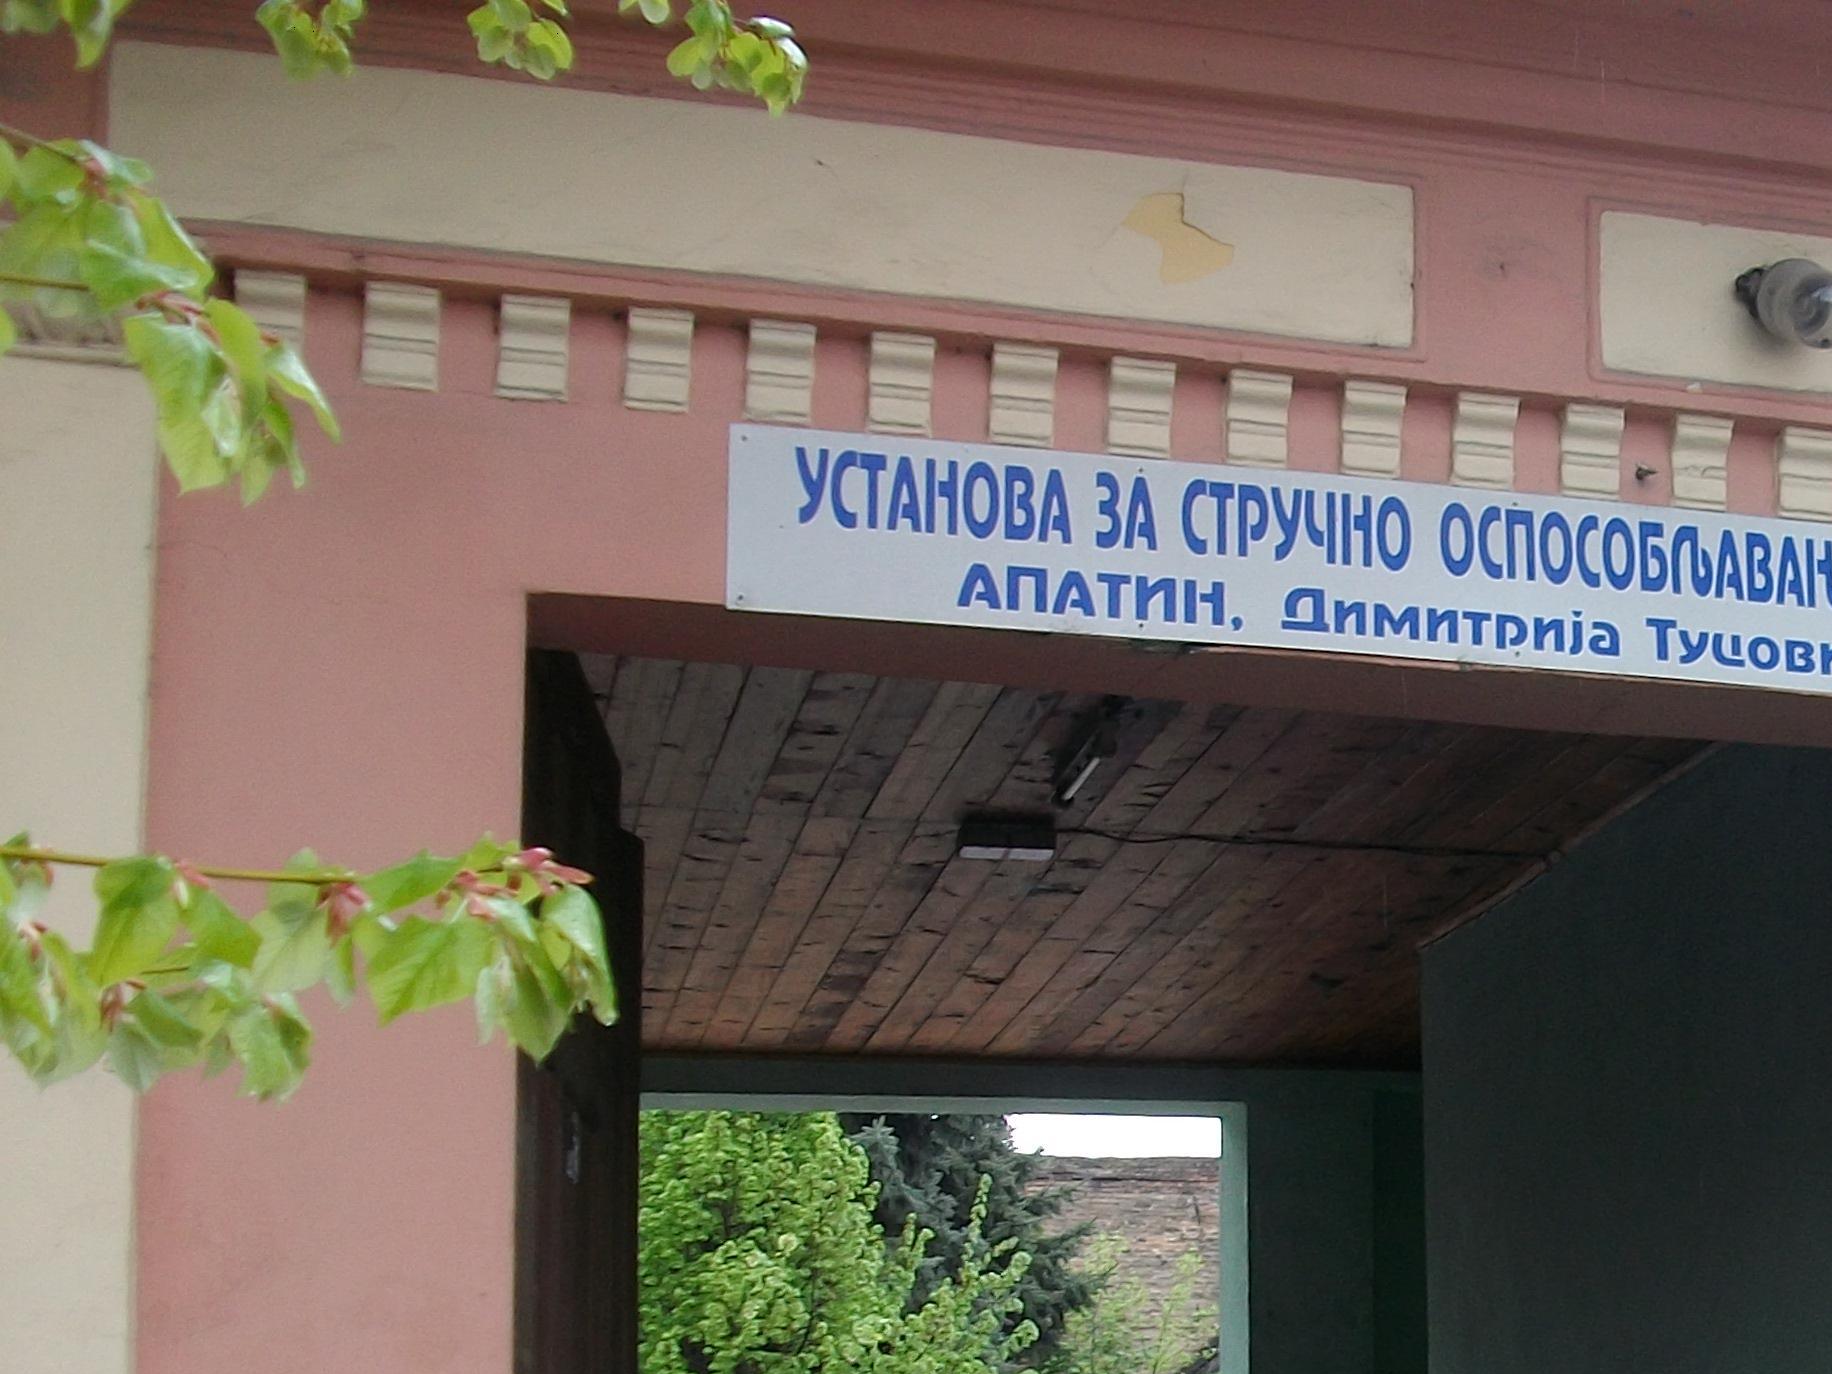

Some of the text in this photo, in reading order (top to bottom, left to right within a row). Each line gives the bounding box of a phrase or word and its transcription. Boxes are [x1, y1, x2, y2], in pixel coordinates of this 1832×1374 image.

[795, 446, 1072, 545] УСТАНОВА
[1095, 474, 1157, 552] ЗА
[1181, 478, 1412, 572] СТРУЧНО
[957, 563, 1243, 632] АПАТИН,
[1281, 587, 1621, 658] Димитрија
